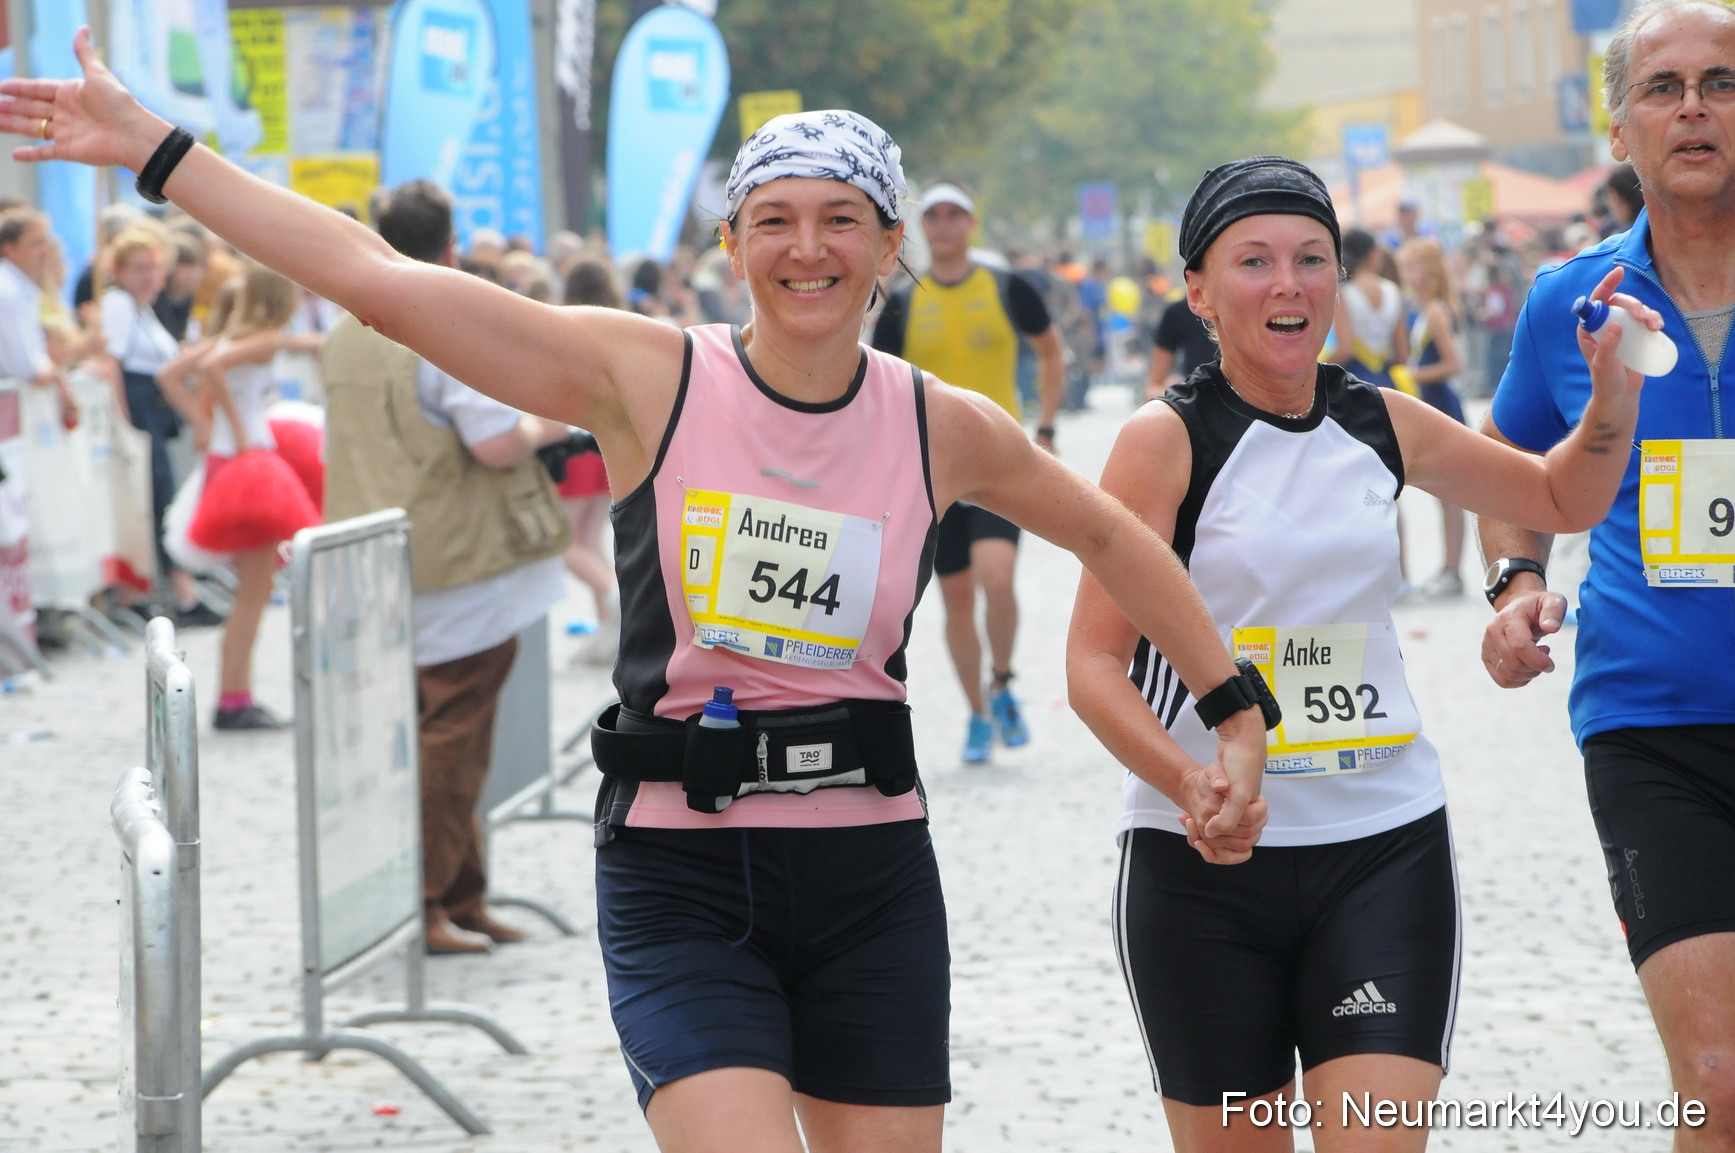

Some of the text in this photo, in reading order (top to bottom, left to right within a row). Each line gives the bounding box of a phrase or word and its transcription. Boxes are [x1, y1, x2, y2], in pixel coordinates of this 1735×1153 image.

[737, 508, 828, 551] Andrea
[690, 548, 700, 570] D
[1660, 569, 1705, 578] BOCK
[748, 560, 841, 616] 544
[786, 639, 855, 660] PFLEIDERER
[1283, 638, 1331, 666] Anke
[1304, 683, 1388, 724] 592
[799, 750, 821, 759] TAO
[1265, 757, 1313, 770] BOCK
[758, 757, 766, 780] TAO
[1332, 1000, 1397, 1017] adidas
